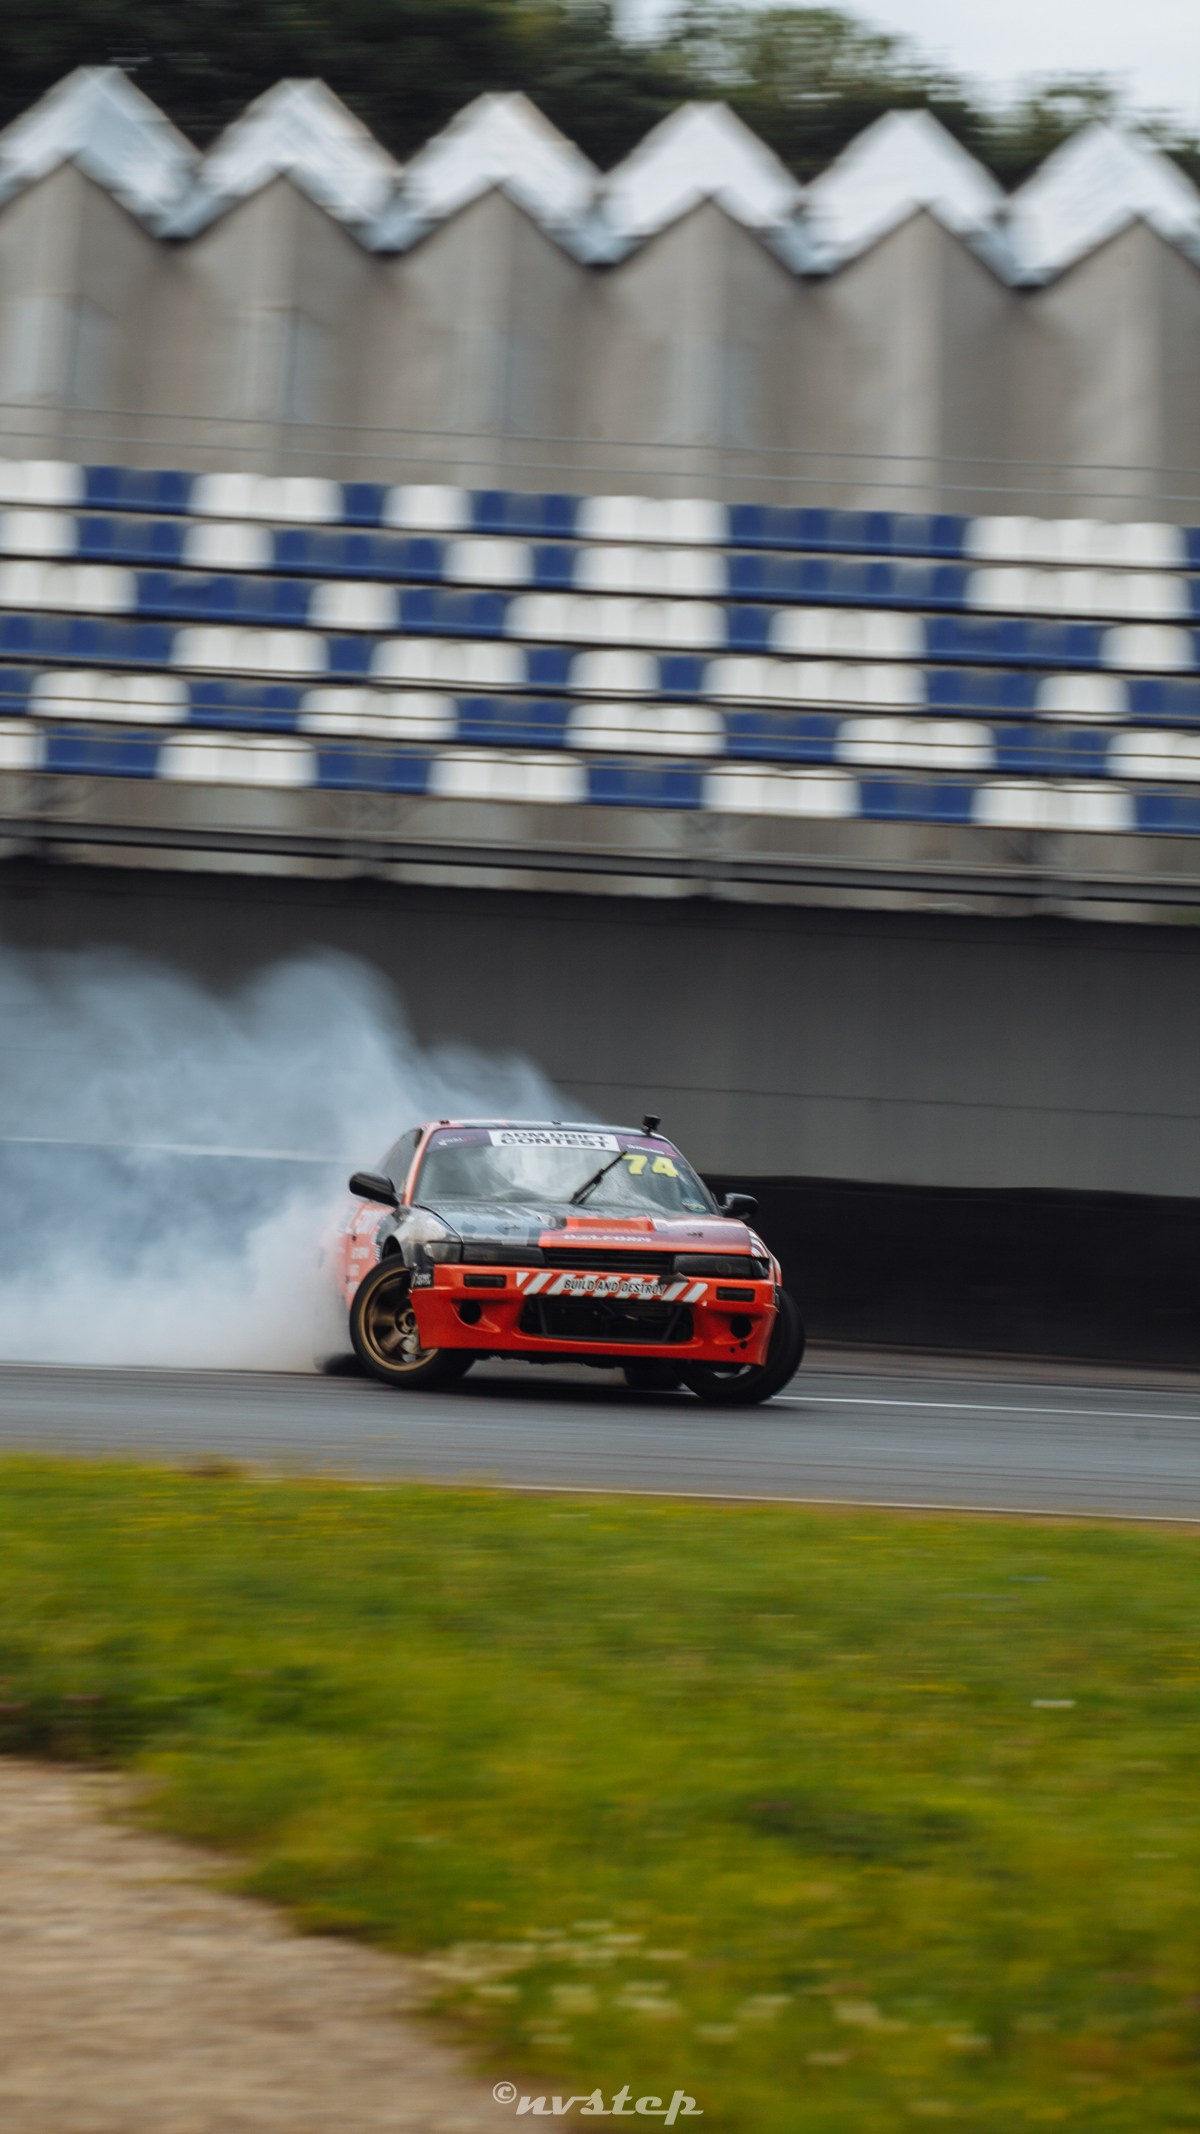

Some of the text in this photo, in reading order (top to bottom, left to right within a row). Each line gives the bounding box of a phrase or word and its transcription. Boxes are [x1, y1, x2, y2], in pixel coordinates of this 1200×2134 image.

[500, 1138, 610, 1148] CONTEST
[549, 1133, 608, 1142] DRIFT
[621, 1154, 679, 1178] 74
[564, 1279, 668, 1295] BUILD AND DESTROY
